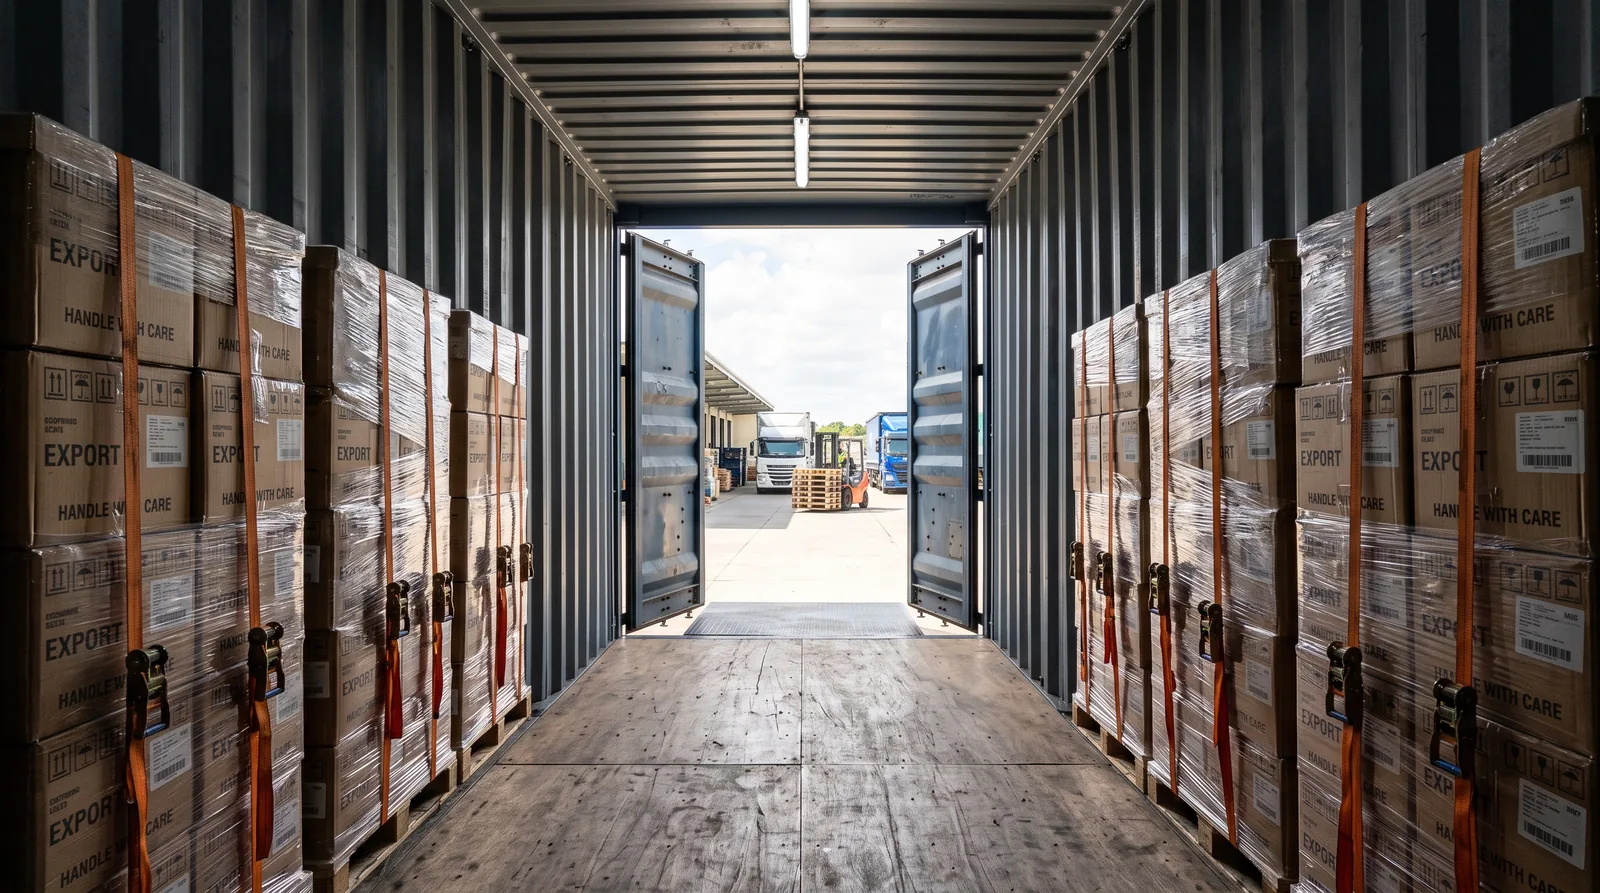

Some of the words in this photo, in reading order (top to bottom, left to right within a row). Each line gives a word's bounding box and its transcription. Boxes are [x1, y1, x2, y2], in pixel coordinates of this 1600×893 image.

[50, 237, 118, 277] EXPOR
[1421, 258, 1461, 289] EXPO
[64, 306, 114, 331] HANDLE
[147, 323, 175, 342] CARE
[1480, 313, 1513, 334] WITH
[1517, 304, 1555, 327] CARE
[218, 337, 240, 354] HAND
[272, 347, 290, 361] CARE
[1364, 339, 1388, 356] CARE
[44, 443, 121, 467] EXPORT
[212, 445, 261, 464] EXPOT
[337, 446, 371, 461] EXPORT
[1206, 445, 1235, 460] EORT
[1300, 449, 1342, 468] EXPORT
[1421, 450, 1488, 472] EXPOT
[58, 502, 110, 522] HANDLE
[144, 497, 172, 513] CARE
[222, 492, 246, 506] HAND
[276, 486, 295, 501] CARE
[1307, 491, 1337, 507] HANDLE
[1360, 496, 1385, 511] CARE
[1433, 503, 1481, 520] HANE
[1483, 505, 1518, 524] WITH
[1522, 508, 1562, 528] CARE
[45, 622, 124, 662] EXPORT
[1422, 614, 1488, 648] EXPT
[1364, 642, 1389, 662] CARE
[58, 678, 112, 710] HANDLE
[342, 669, 374, 697] EXPORT
[1484, 680, 1519, 707] WITH
[1522, 693, 1563, 721] CARE
[1249, 716, 1267, 735] CARE
[1301, 708, 1343, 744] EXPORT
[1308, 749, 1338, 777] HANDLE
[1363, 780, 1388, 804] CARE
[49, 794, 113, 847] EXPOR
[145, 808, 174, 837] CARE
[1302, 831, 1337, 873] EXPOR
[60, 844, 113, 889] HANDLE
[1490, 852, 1524, 885] WITH
